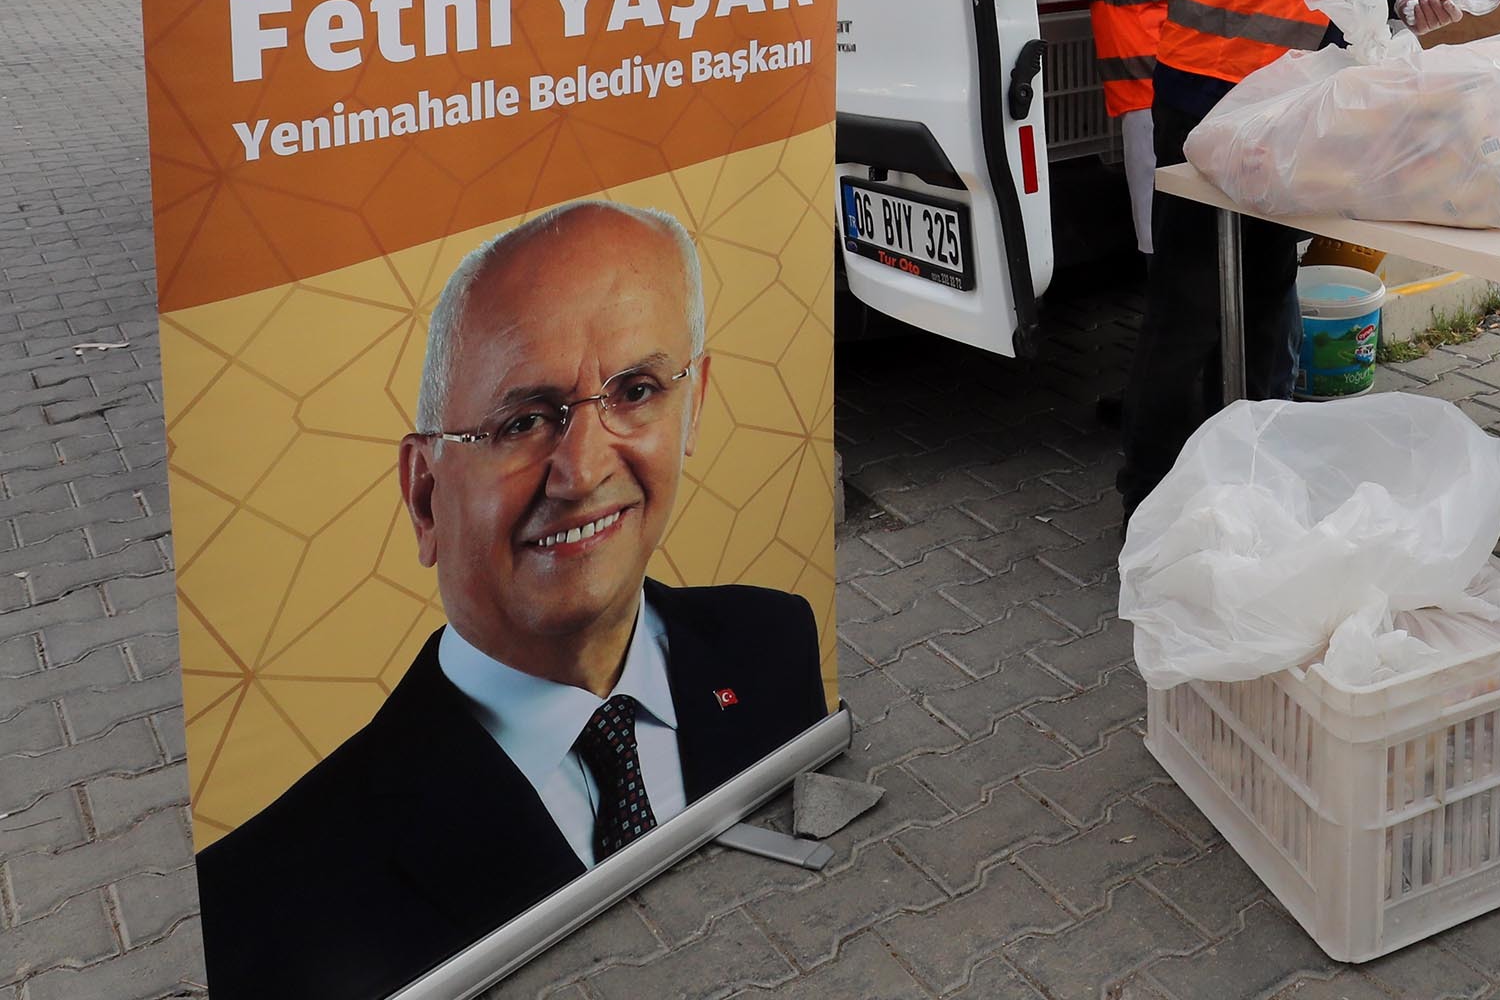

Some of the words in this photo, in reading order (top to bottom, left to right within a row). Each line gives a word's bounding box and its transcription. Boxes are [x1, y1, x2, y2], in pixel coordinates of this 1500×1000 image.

[232, 82, 519, 161] Yenimahalle
[530, 55, 683, 105] Belediye
[692, 38, 812, 82] Başkanı
[854, 191, 874, 240] 06
[882, 198, 914, 253] BVY
[923, 209, 960, 266] 325
[878, 250, 897, 267] Tur
[899, 258, 920, 276] Oto
